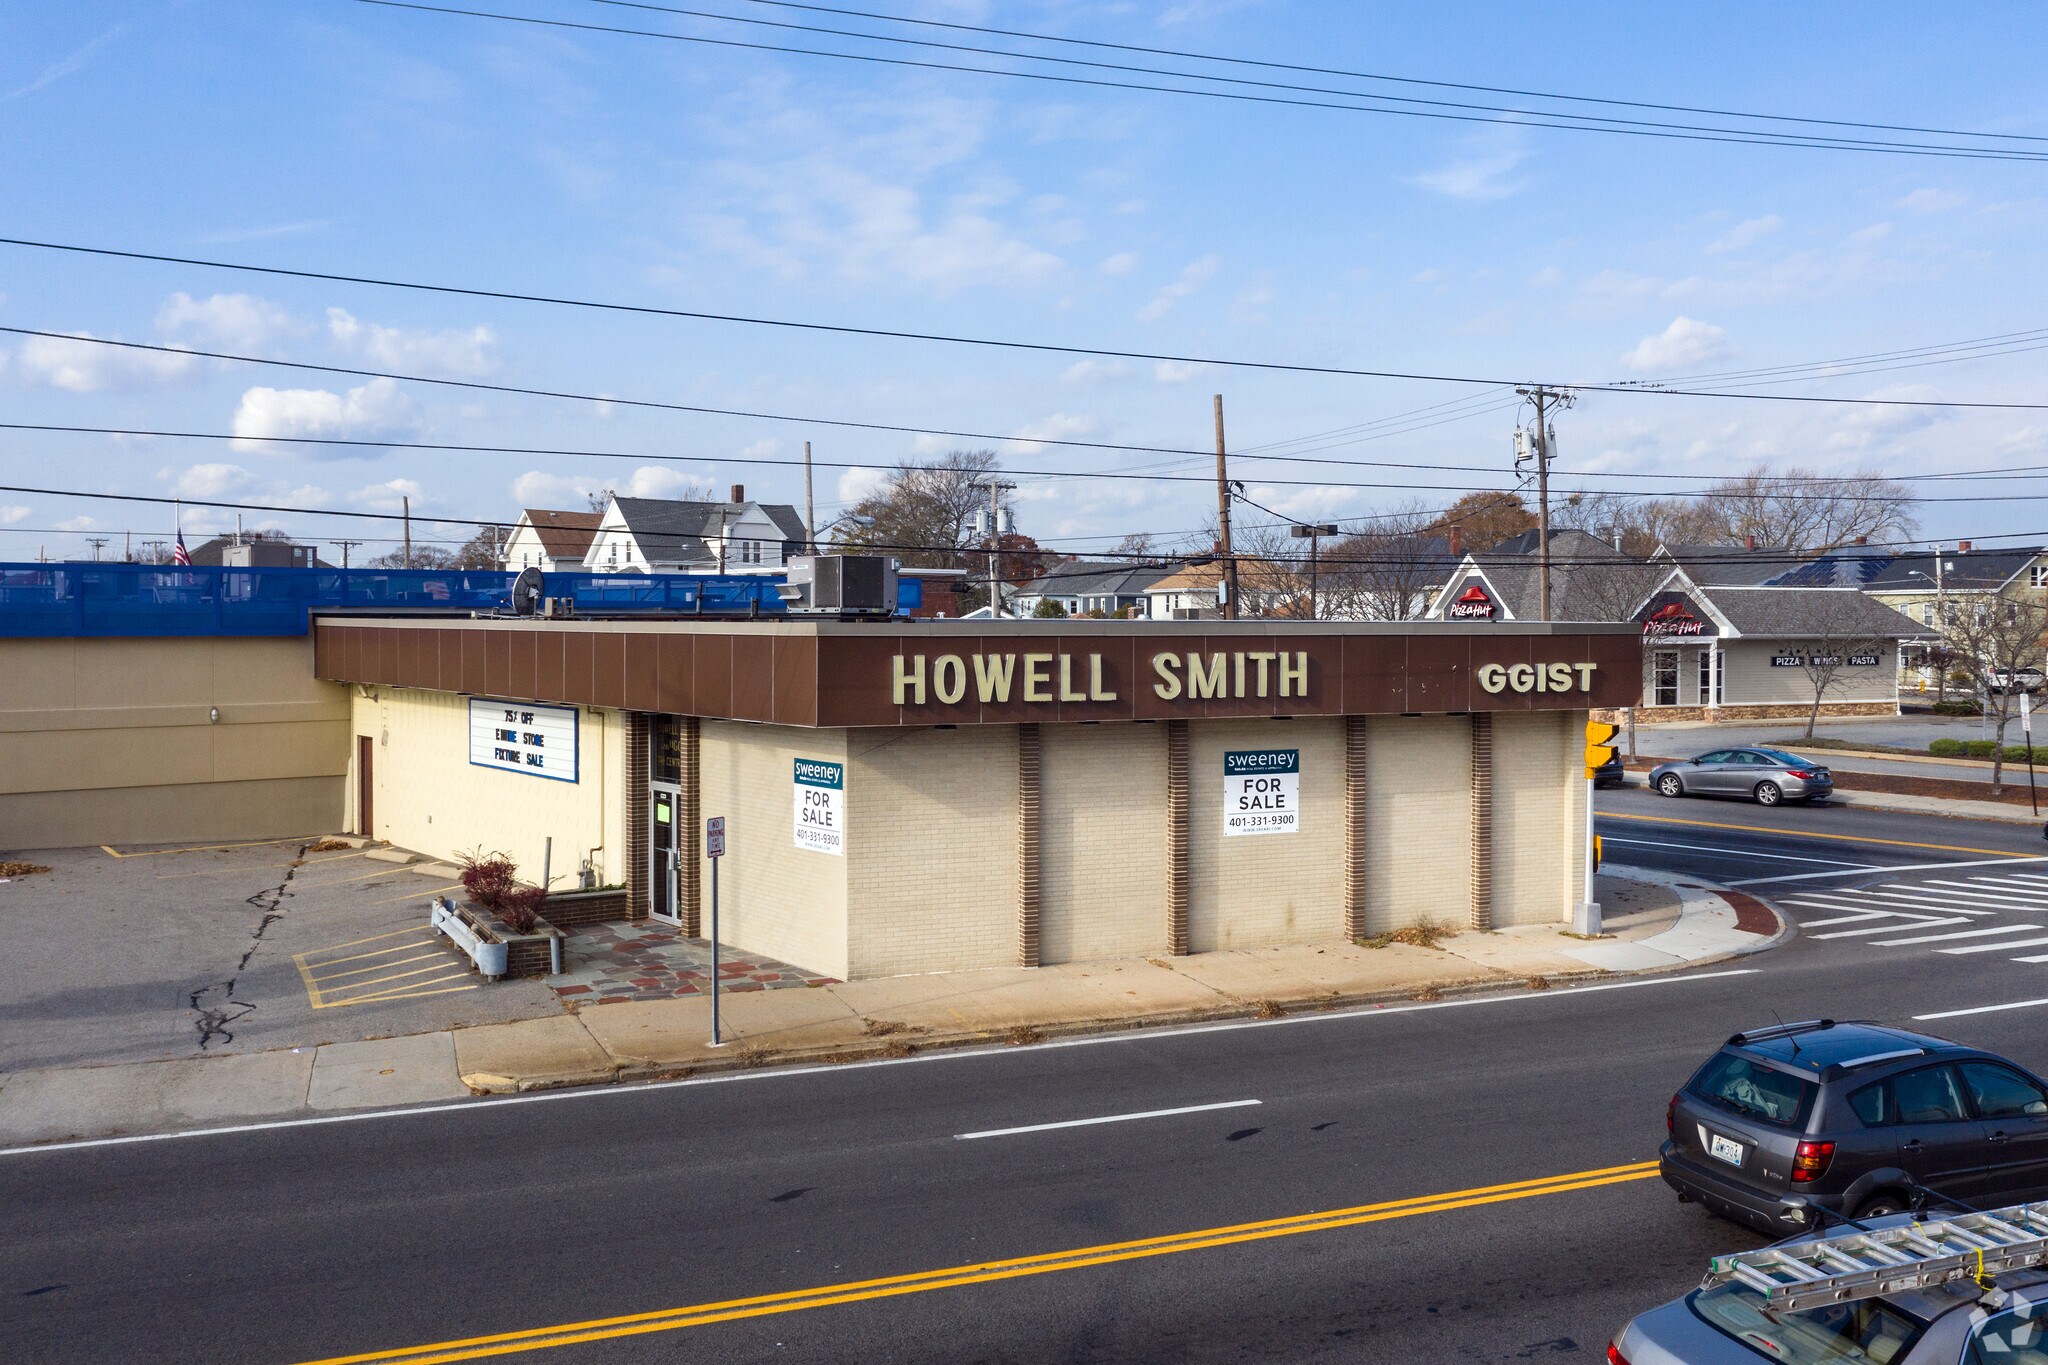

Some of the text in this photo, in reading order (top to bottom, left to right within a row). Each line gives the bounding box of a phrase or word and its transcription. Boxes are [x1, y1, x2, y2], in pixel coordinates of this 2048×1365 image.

[1776, 657, 1800, 666] PIZZA
[1852, 656, 1876, 665] PASTA
[892, 651, 1308, 705] HOWELL SMITH
[1478, 662, 1597, 694] GGIST
[521, 711, 534, 725] OFF
[523, 732, 544, 747] STORE
[494, 747, 544, 768] FIXTURE SALE
[1228, 753, 1295, 768] sweeney
[795, 762, 841, 784] sweeney
[1243, 778, 1281, 793] FOR
[805, 790, 830, 808] FOR
[1239, 794, 1285, 810] SALE
[712, 820, 719, 829] NO
[802, 807, 833, 827] SALE
[1229, 814, 1294, 827] 401-331-9300
[796, 828, 840, 846] 401-331-9300
